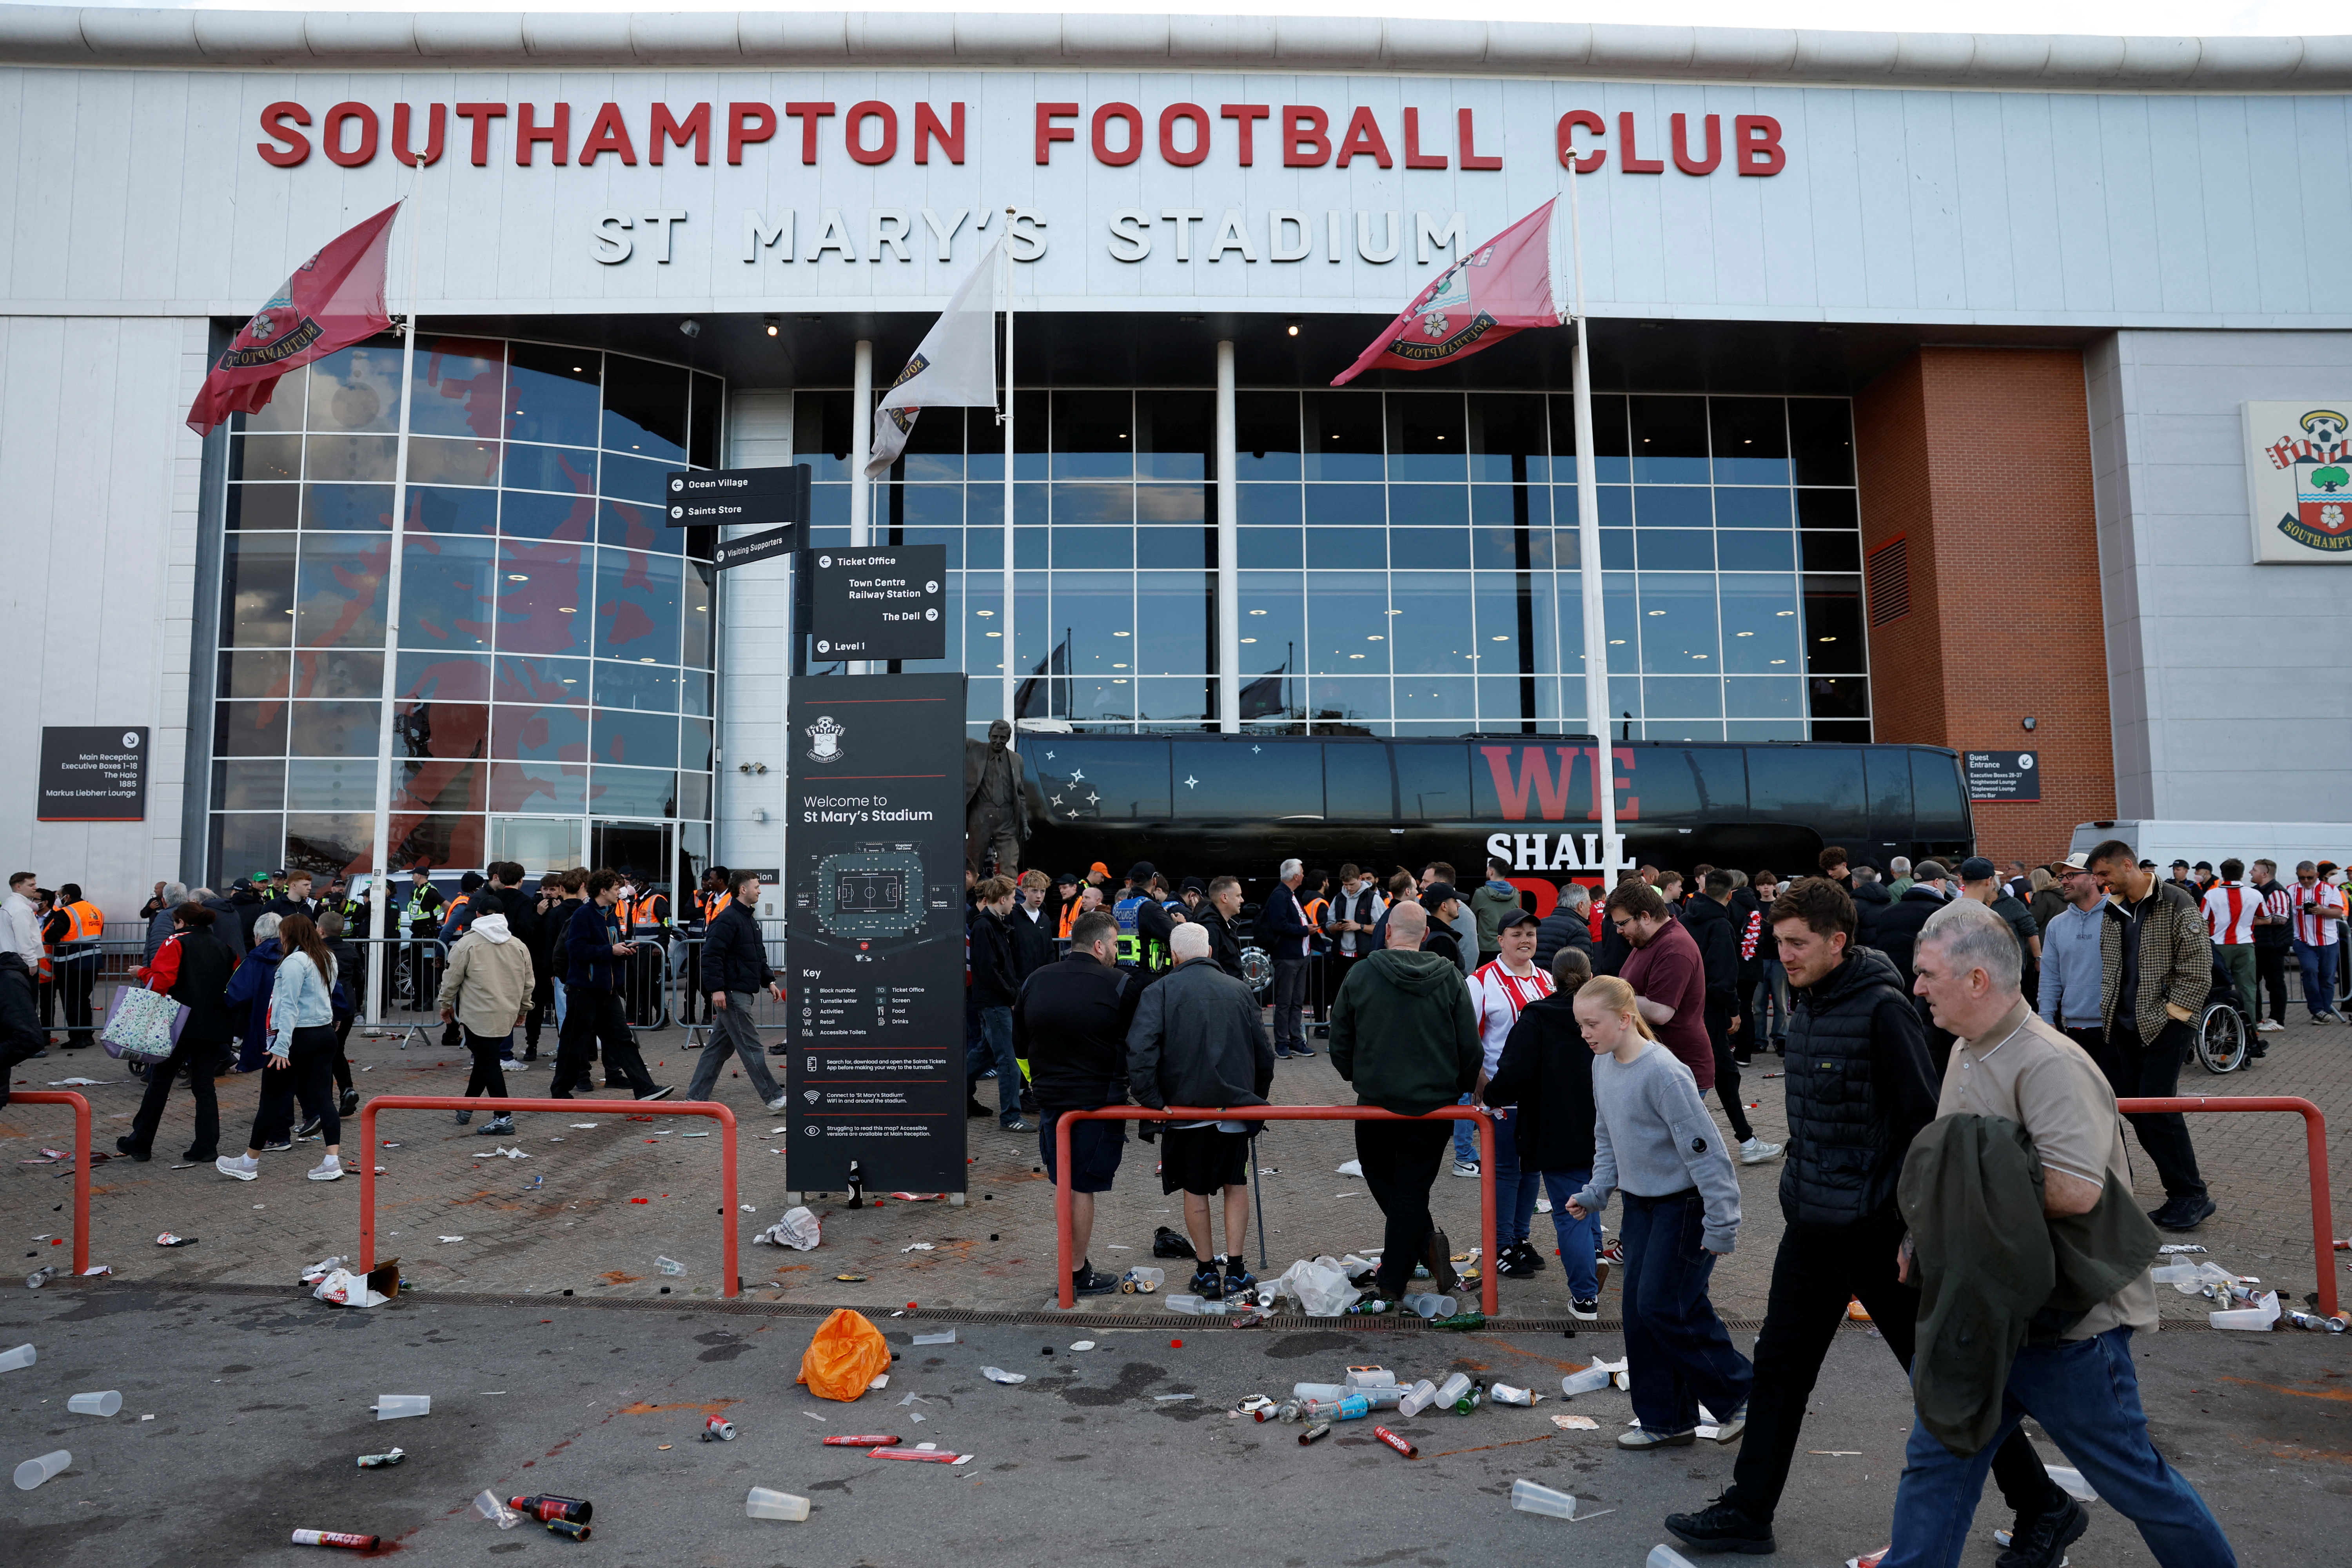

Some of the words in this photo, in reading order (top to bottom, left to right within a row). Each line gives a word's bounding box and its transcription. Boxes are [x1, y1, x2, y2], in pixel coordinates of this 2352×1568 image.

[257, 101, 965, 167] SOUTHAMPTON
[1035, 102, 1503, 170] FOOTBALL
[1557, 109, 1787, 177] CLUB
[590, 209, 687, 265] ST
[1108, 208, 1467, 265] STADIUM
[2284, 521, 2352, 548] SOUTHAMPT
[728, 547, 749, 557] Visiting
[750, 538, 782, 551] Supporters
[849, 591, 884, 599] Railway
[809, 752, 835, 761] SOUTHAMPTON
[1480, 747, 1639, 820] WE
[804, 796, 869, 807] Welcome
[873, 795, 887, 806] to
[804, 812, 817, 822] St
[872, 809, 932, 821] Stadium
[1486, 833, 1636, 870] SHALL
[1116, 910, 1132, 920] POLICE
[804, 969, 821, 979] Key
[1387, 1434, 1406, 1450] SMOKE
[327, 1533, 367, 1545] SMOKE
